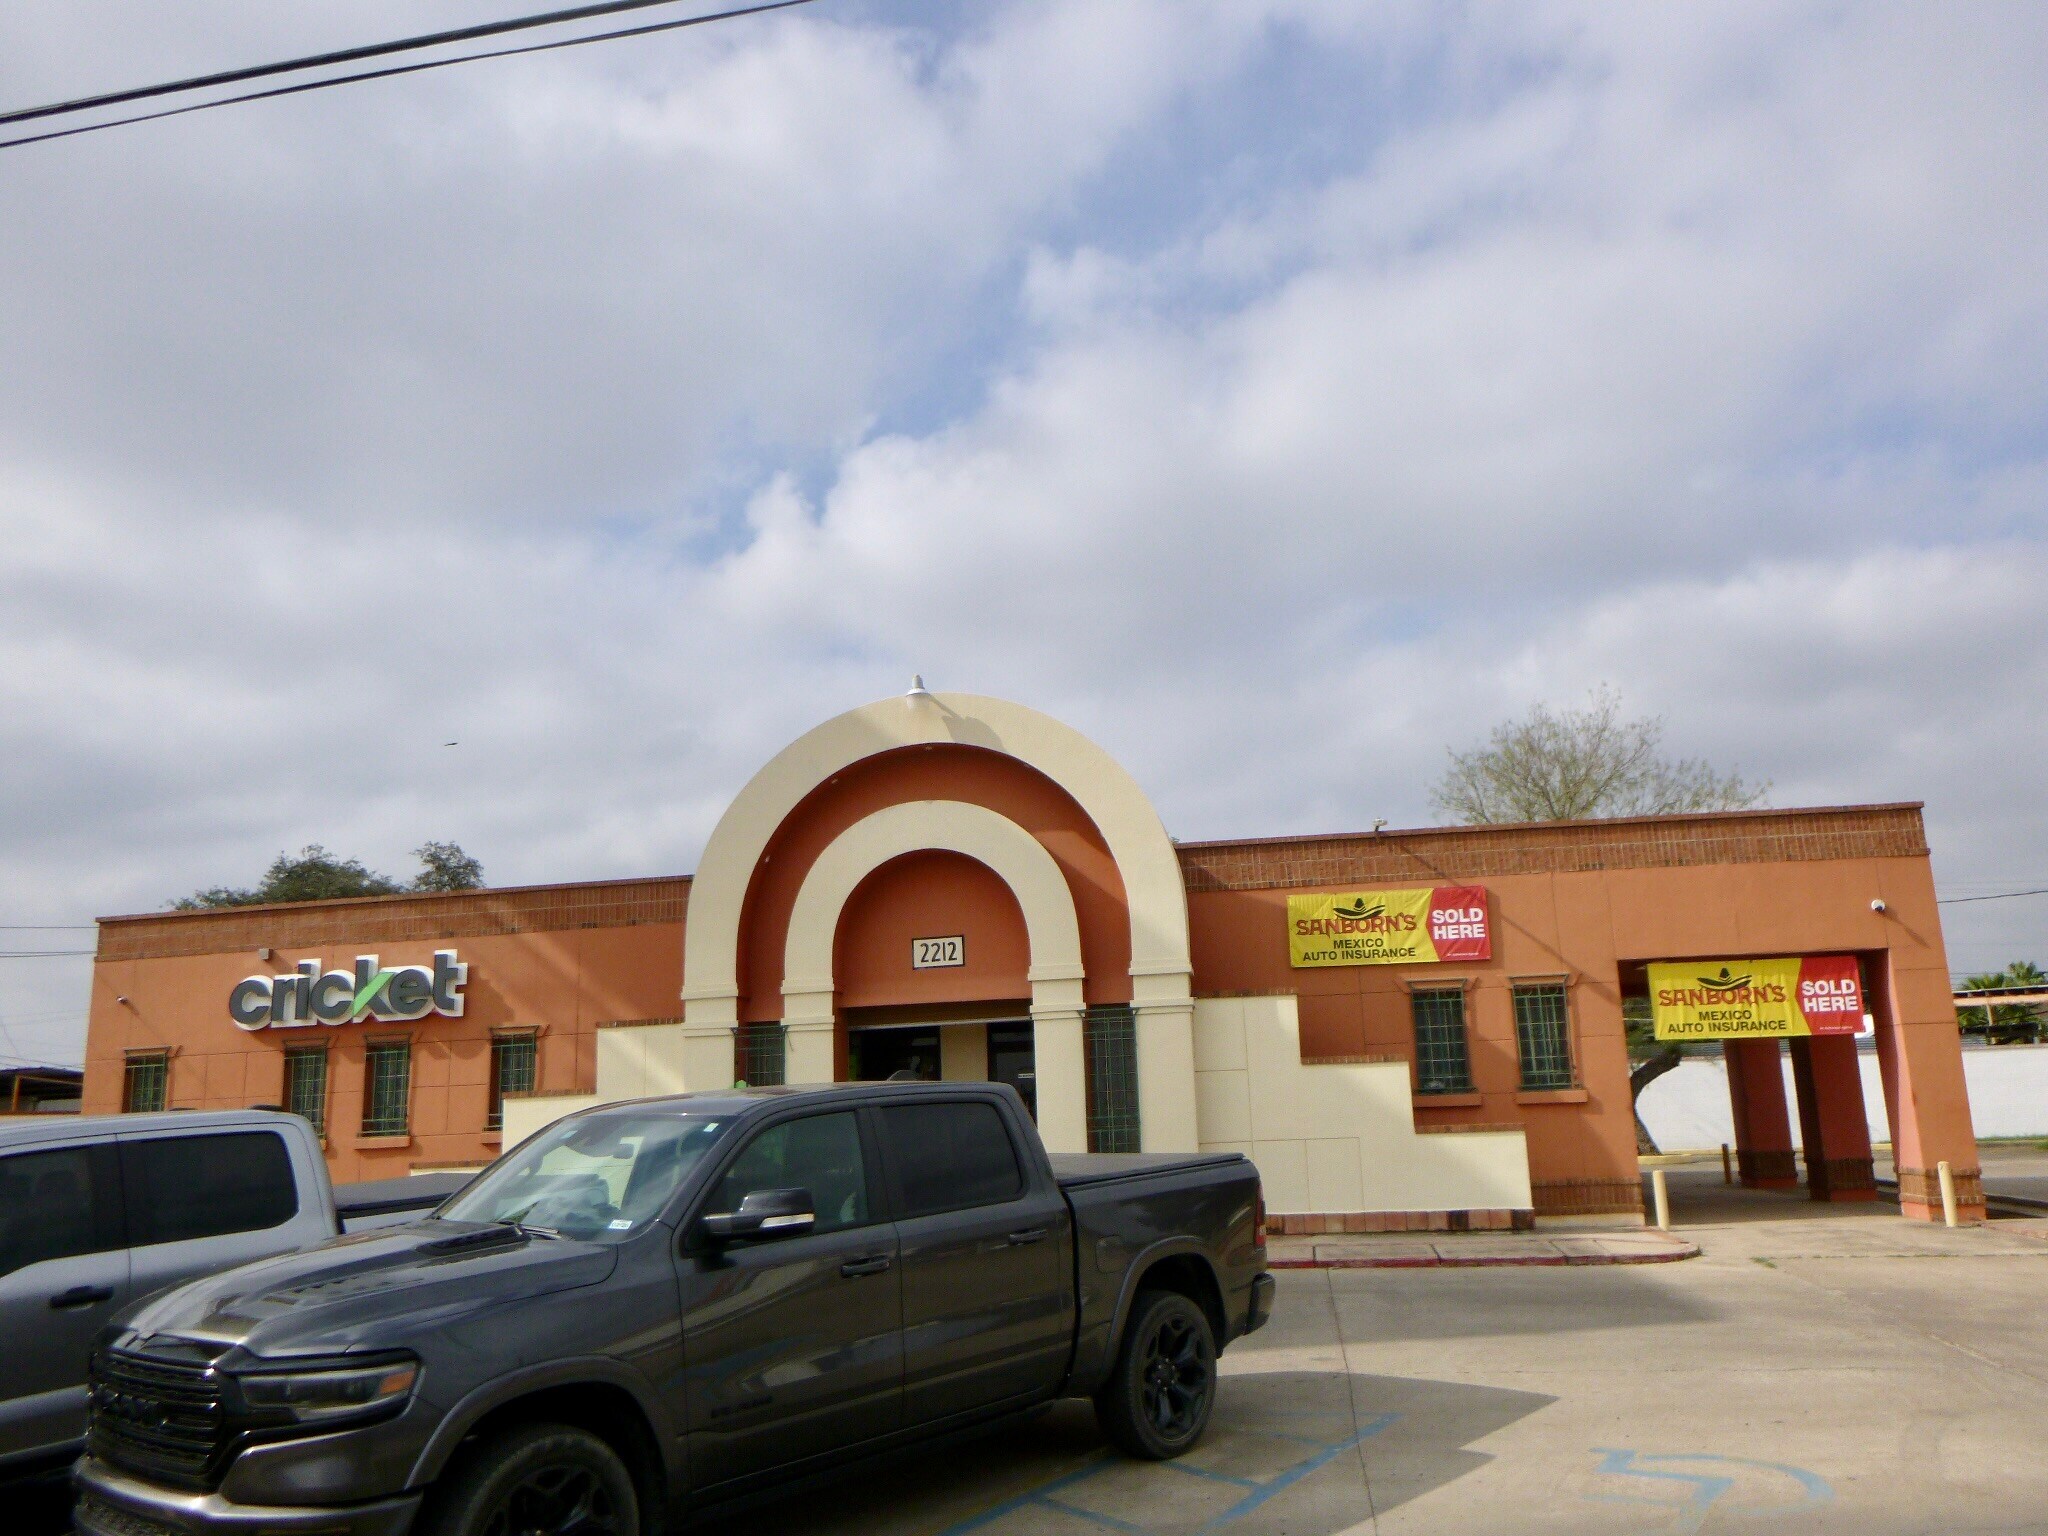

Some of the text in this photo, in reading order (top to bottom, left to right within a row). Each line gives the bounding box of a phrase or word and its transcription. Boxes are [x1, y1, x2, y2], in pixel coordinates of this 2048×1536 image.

[1432, 907, 1484, 923] SOLD
[1296, 912, 1418, 938] SANBORN'S
[1433, 923, 1486, 940] HERE
[920, 941, 958, 963] 2212
[1333, 938, 1384, 950] MEXICO
[1303, 947, 1417, 962] AUTO INSURANCE
[229, 951, 465, 1027] cricket
[1658, 983, 1787, 1008] SANBORN'S
[1802, 979, 1856, 996] SOLD
[1804, 996, 1859, 1013] HERE
[1698, 1010, 1752, 1021] MEXICO
[1667, 1020, 1787, 1033] AUTO INSURANCE
